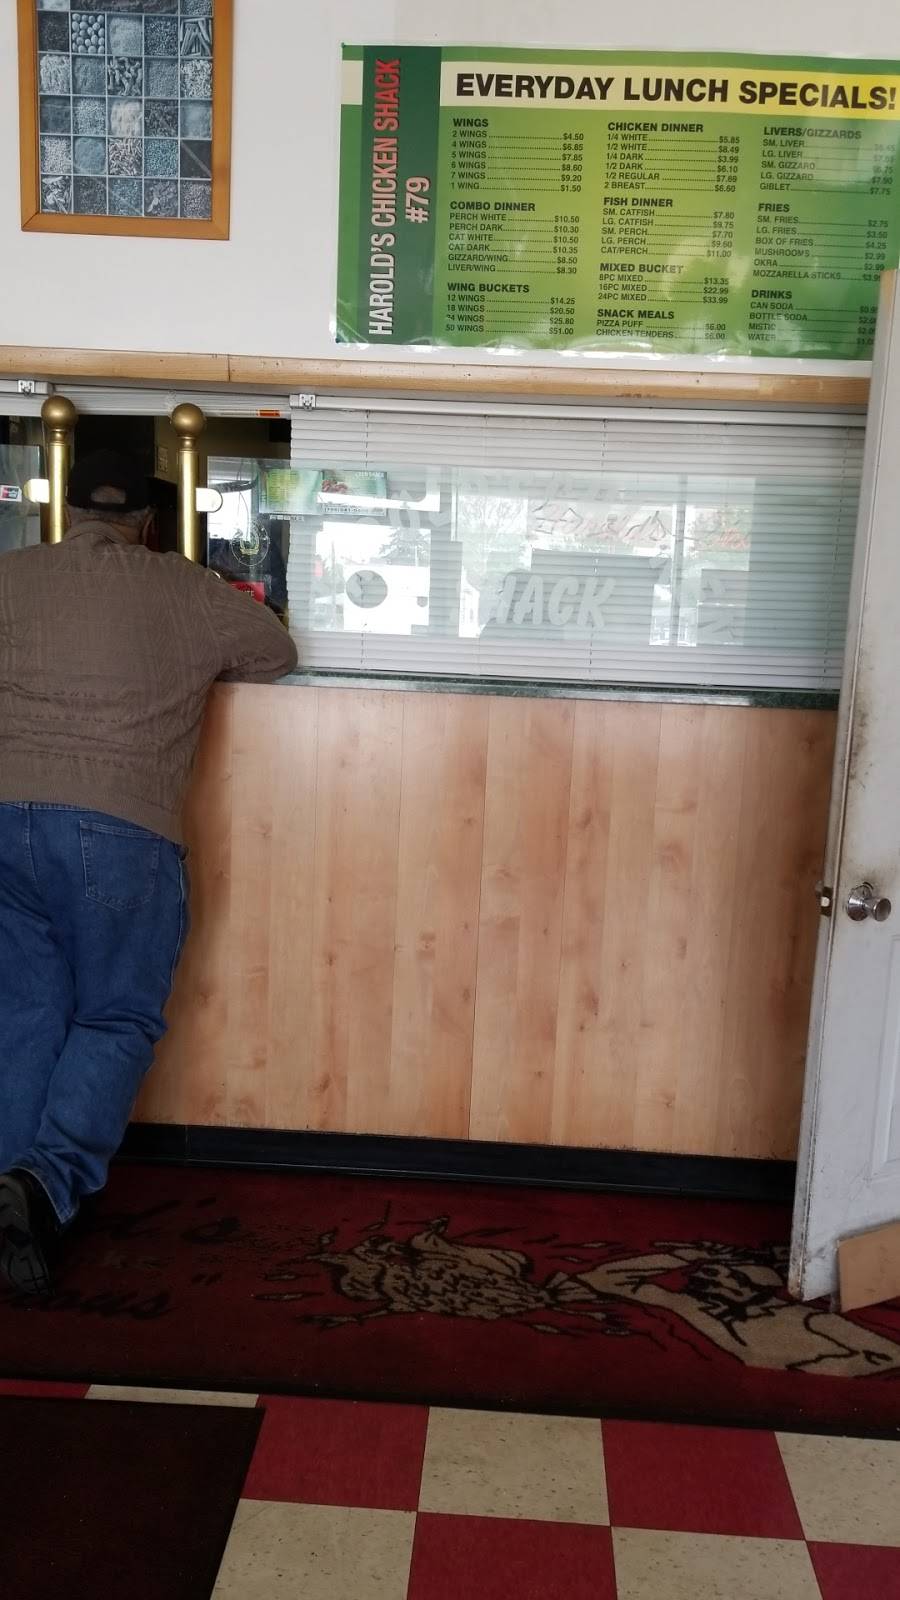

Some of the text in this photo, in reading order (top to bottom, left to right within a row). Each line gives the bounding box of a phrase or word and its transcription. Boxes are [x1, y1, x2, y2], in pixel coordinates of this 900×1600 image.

[456, 73, 896, 110] EVERYDAY LUNCH SPECIALS!
[453, 119, 488, 127] WINGS
[608, 122, 704, 133] CHICKEN DINNER
[460, 130, 487, 138] WINGS
[764, 127, 862, 139] LIVERS/GIZZARDS
[763, 139, 804, 148] SM. LIVER
[762, 150, 802, 158] LG. LIVER
[561, 164, 582, 172] $8.60
[778, 162, 815, 170] GIZZARD
[458, 172, 485, 180] WINGS
[777, 172, 814, 180] GIZZARD
[458, 182, 479, 190] WING
[612, 182, 645, 190] BREAST
[369, 58, 400, 335] HAROLD'S CHICKEN SHACK
[405, 175, 430, 224] #79
[604, 197, 673, 207] FISH DINNER
[451, 202, 535, 211] COMBO DINNER
[758, 203, 790, 212] FRIES
[774, 216, 799, 224] FRIES
[756, 226, 770, 234] LG.
[468, 233, 493, 241] WHITE
[618, 237, 646, 245] PERCH
[756, 237, 773, 245] BOX
[790, 238, 814, 246] FRIES
[755, 248, 810, 256] MUSHROOMS
[449, 254, 508, 262] GIZZARD/WING
[754, 258, 778, 266] OKRA
[448, 264, 496, 272] LIVER/WING
[600, 263, 684, 273] MIXED BUCKET
[618, 274, 643, 282] MIXED
[753, 270, 809, 279] MOZZARELLA
[811, 272, 841, 280] STICKS
[448, 283, 530, 293] WING BUCKETS
[752, 290, 792, 299] DRINKS
[597, 309, 674, 319] SNACK MEALS
[750, 312, 781, 320] BOTTLE
[458, 325, 484, 333] WINGS
[596, 329, 633, 337] CHICKEN
[636, 330, 673, 339] TENDERS
